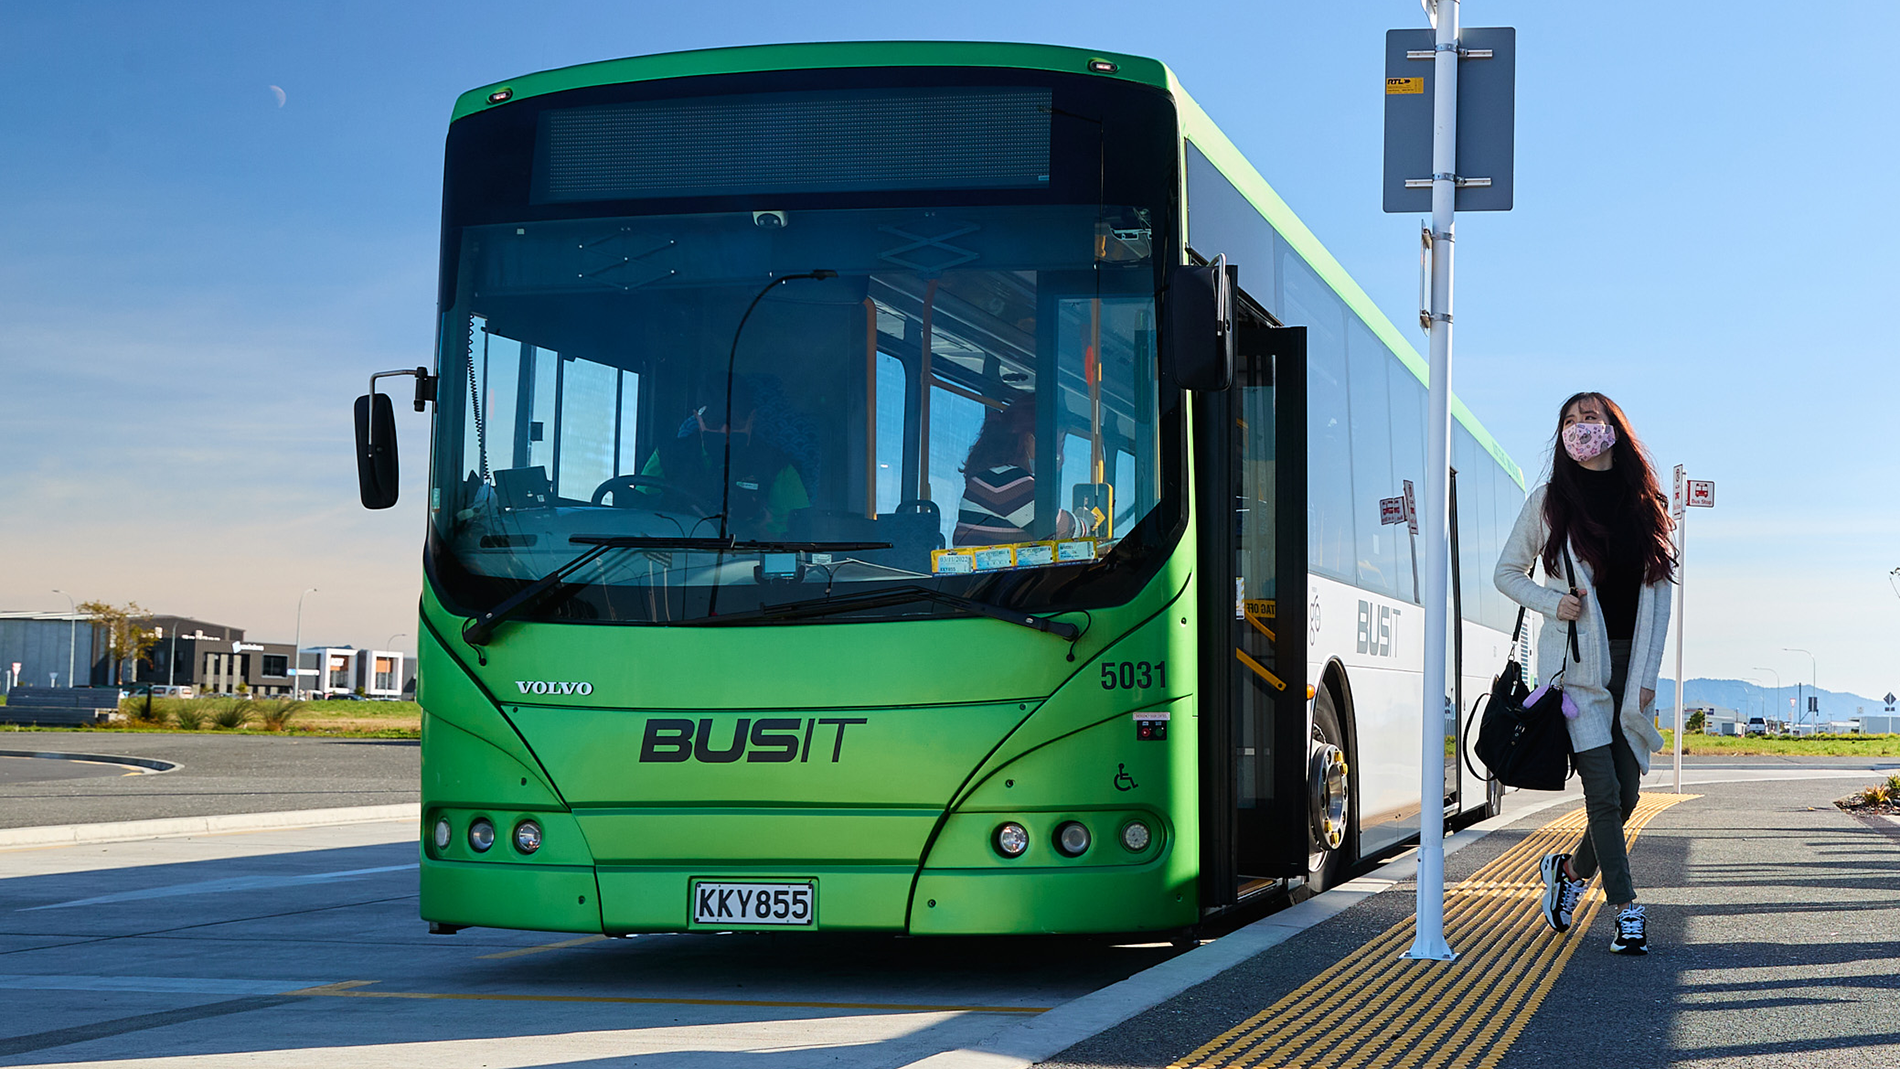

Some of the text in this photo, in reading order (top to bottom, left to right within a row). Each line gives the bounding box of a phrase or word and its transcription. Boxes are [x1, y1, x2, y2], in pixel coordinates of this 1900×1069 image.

[1357, 600, 1401, 658] BUSIT
[515, 681, 594, 695] VOLVO
[1100, 660, 1166, 690] 5031
[639, 718, 868, 763] BUSIT
[698, 888, 810, 920] KKY855
